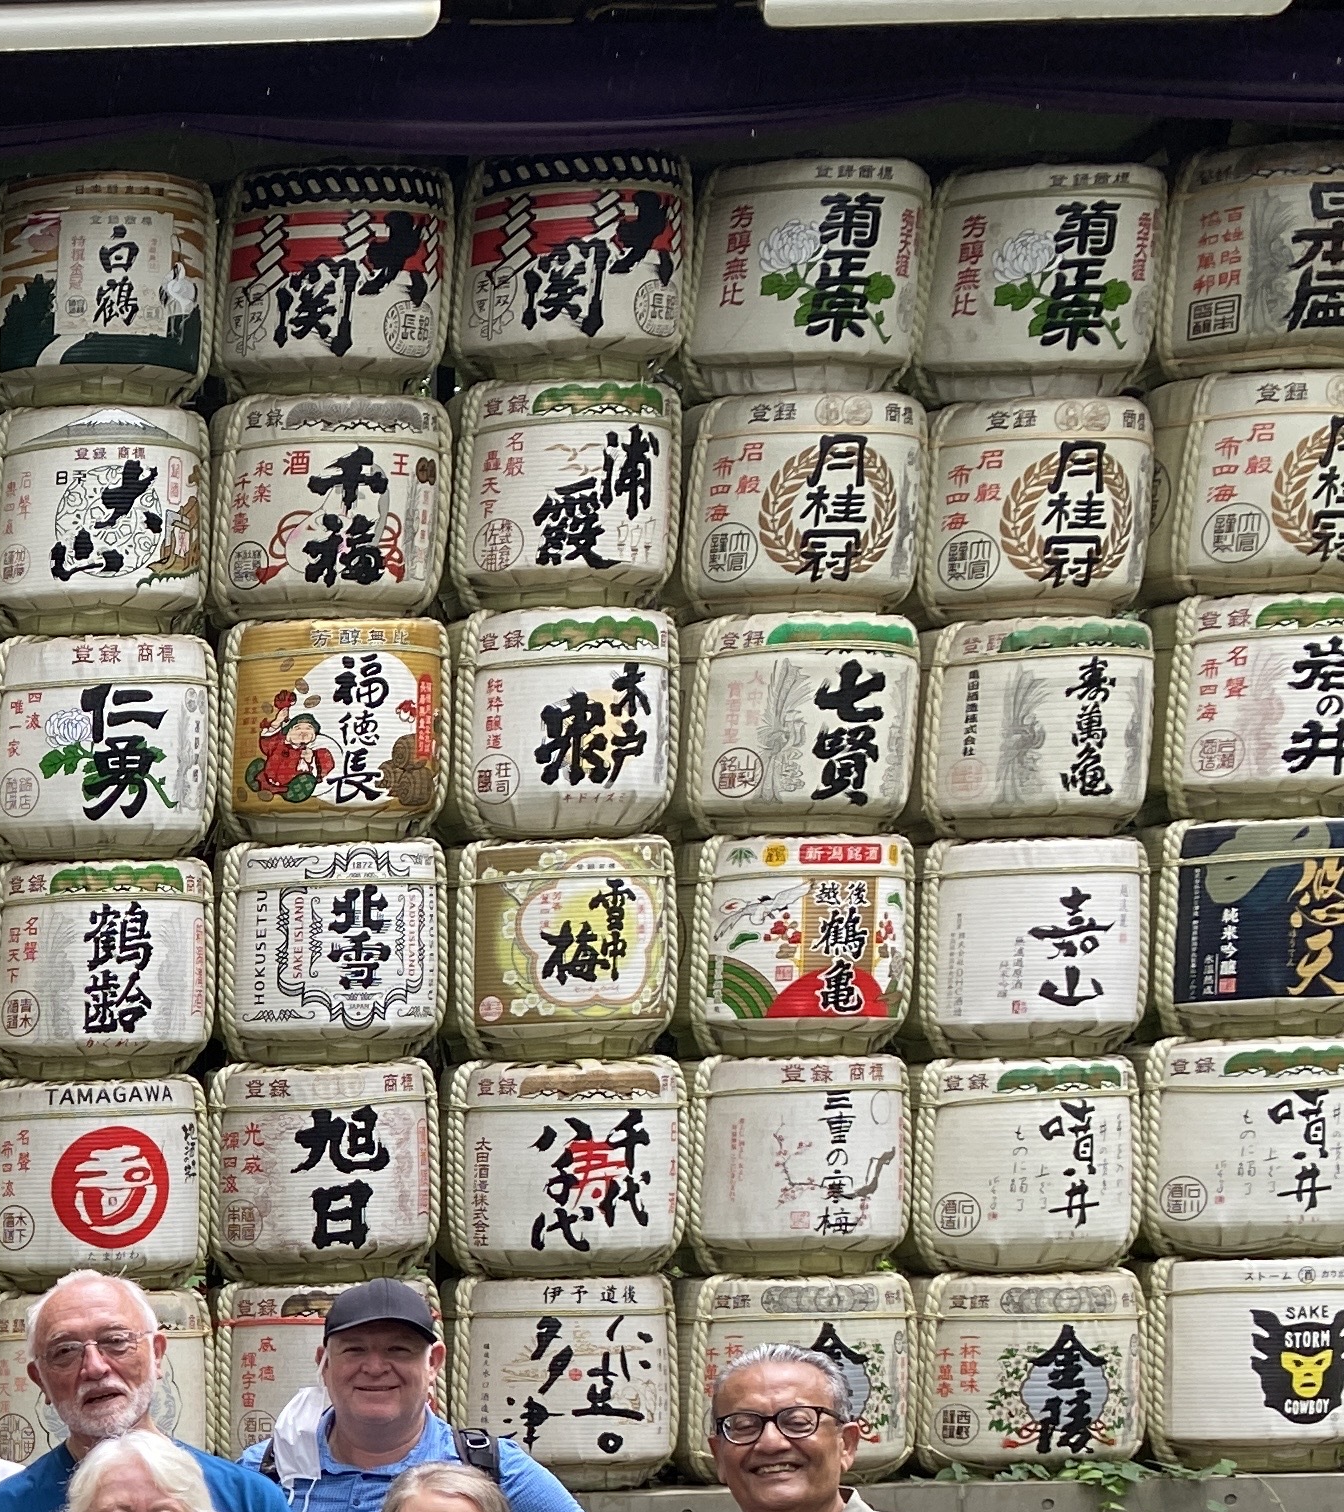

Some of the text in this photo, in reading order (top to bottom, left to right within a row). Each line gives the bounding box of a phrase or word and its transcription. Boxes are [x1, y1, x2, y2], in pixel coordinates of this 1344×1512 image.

[93, 226, 139, 328] 白鶴
[274, 211, 428, 357] 大関
[521, 190, 674, 337] 大関
[806, 193, 885, 343] 菊正宗
[1041, 201, 1121, 350] 菊正宗
[391, 453, 409, 476] 王
[533, 424, 659, 569] 浦霞
[797, 433, 870, 581] 月桂冠
[1039, 441, 1107, 588] 月桂冠
[312, 630, 408, 648] 芳醇無比
[81, 684, 169, 821] 仁勇
[327, 655, 390, 804] 福徳長
[811, 659, 886, 806] 七賢
[352, 861, 373, 869] 1872
[805, 846, 880, 862] 新潟銘酒
[815, 880, 869, 906] 越後
[254, 890, 267, 1005] HOKUSETSU
[293, 897, 304, 979] SAKE ISLAND
[327, 884, 392, 990] 北雪
[541, 878, 636, 986] 雪中梅
[812, 907, 868, 1013] 鶴亀
[1220, 908, 1240, 976] 純米吟醸
[46, 1085, 173, 1107] TAMAGAWA
[291, 1104, 390, 1249] 旭日
[472, 1137, 491, 1247] 太田酒造株式会社
[816, 1090, 857, 1235] 三重の寒梅
[1039, 1100, 1099, 1228] 噴井
[1268, 1089, 1331, 1212] 噴井
[87, 1250, 139, 1261] たまがわ
[543, 1285, 638, 1304] 伊予 道後
[1245, 1272, 1292, 1281] ストーム
[960, 1335, 981, 1393] 一杯醇味
[1284, 1330, 1330, 1348] STORM
[1285, 1305, 1329, 1319] SAKE
[1284, 1399, 1329, 1414] COWBOY
